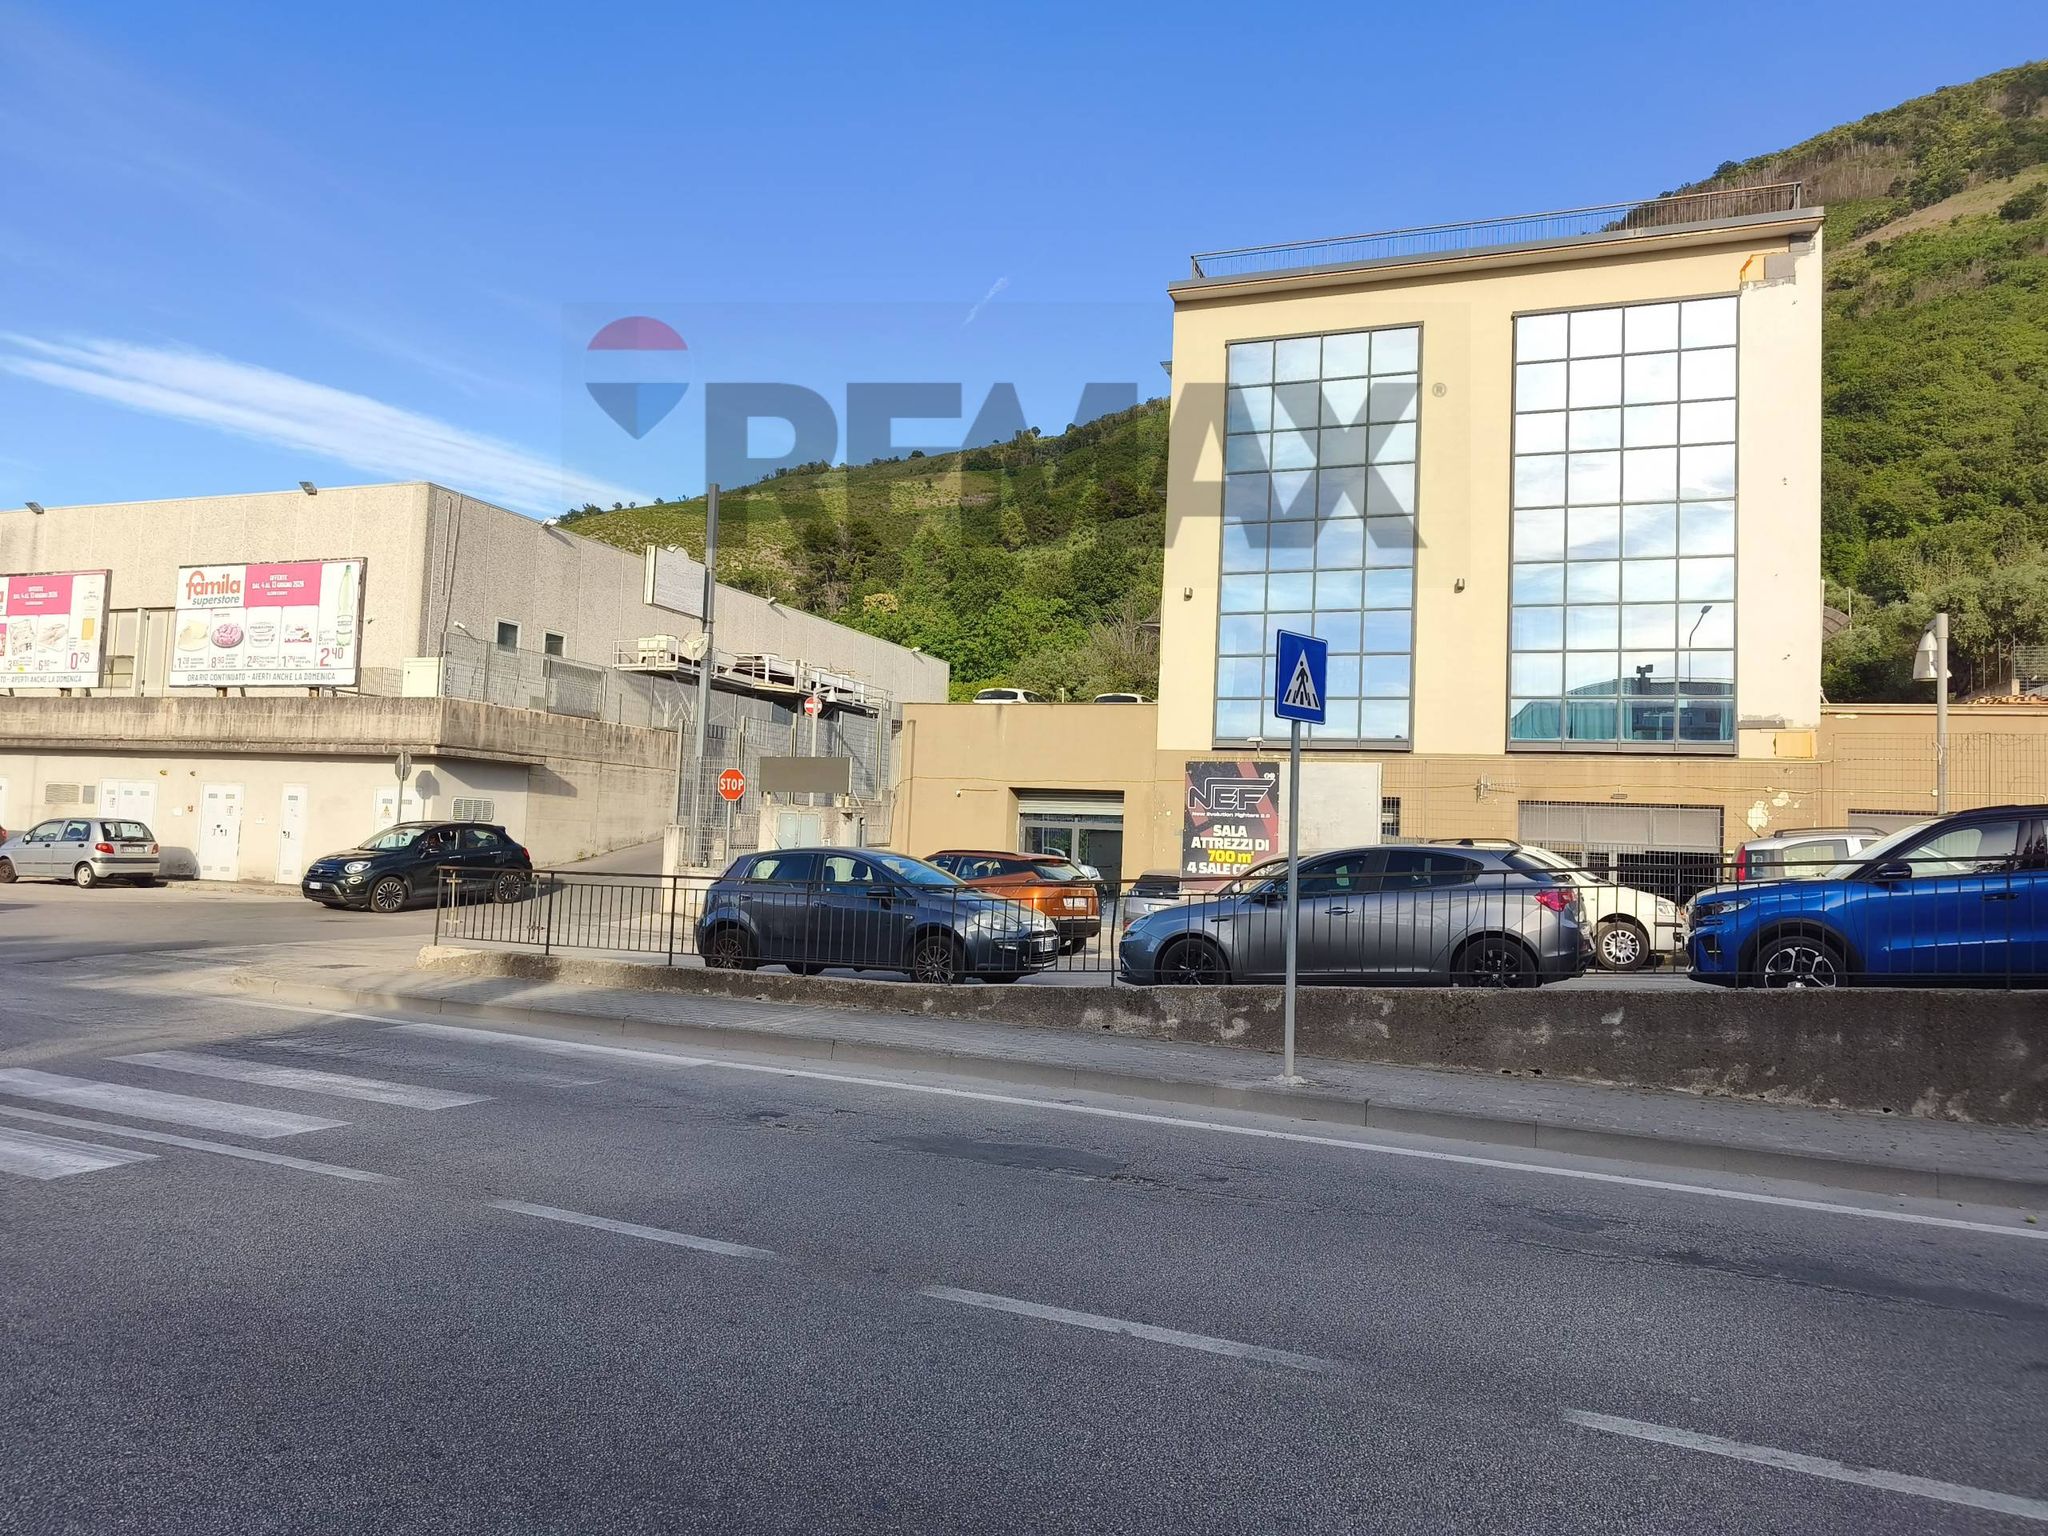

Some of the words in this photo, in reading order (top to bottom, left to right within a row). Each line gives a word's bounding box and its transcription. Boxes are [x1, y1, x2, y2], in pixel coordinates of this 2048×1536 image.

[186, 570, 241, 600] famila
[192, 595, 240, 607] superstore
[720, 778, 744, 790] STOP
[1188, 777, 1275, 810] NEF
[1213, 825, 1247, 837] SALA
[1191, 836, 1252, 850] ATTREZZI
[1255, 839, 1270, 851] DI
[1207, 849, 1236, 863] 700
[1187, 861, 1197, 873] 4
[1198, 861, 1231, 875] SALE
